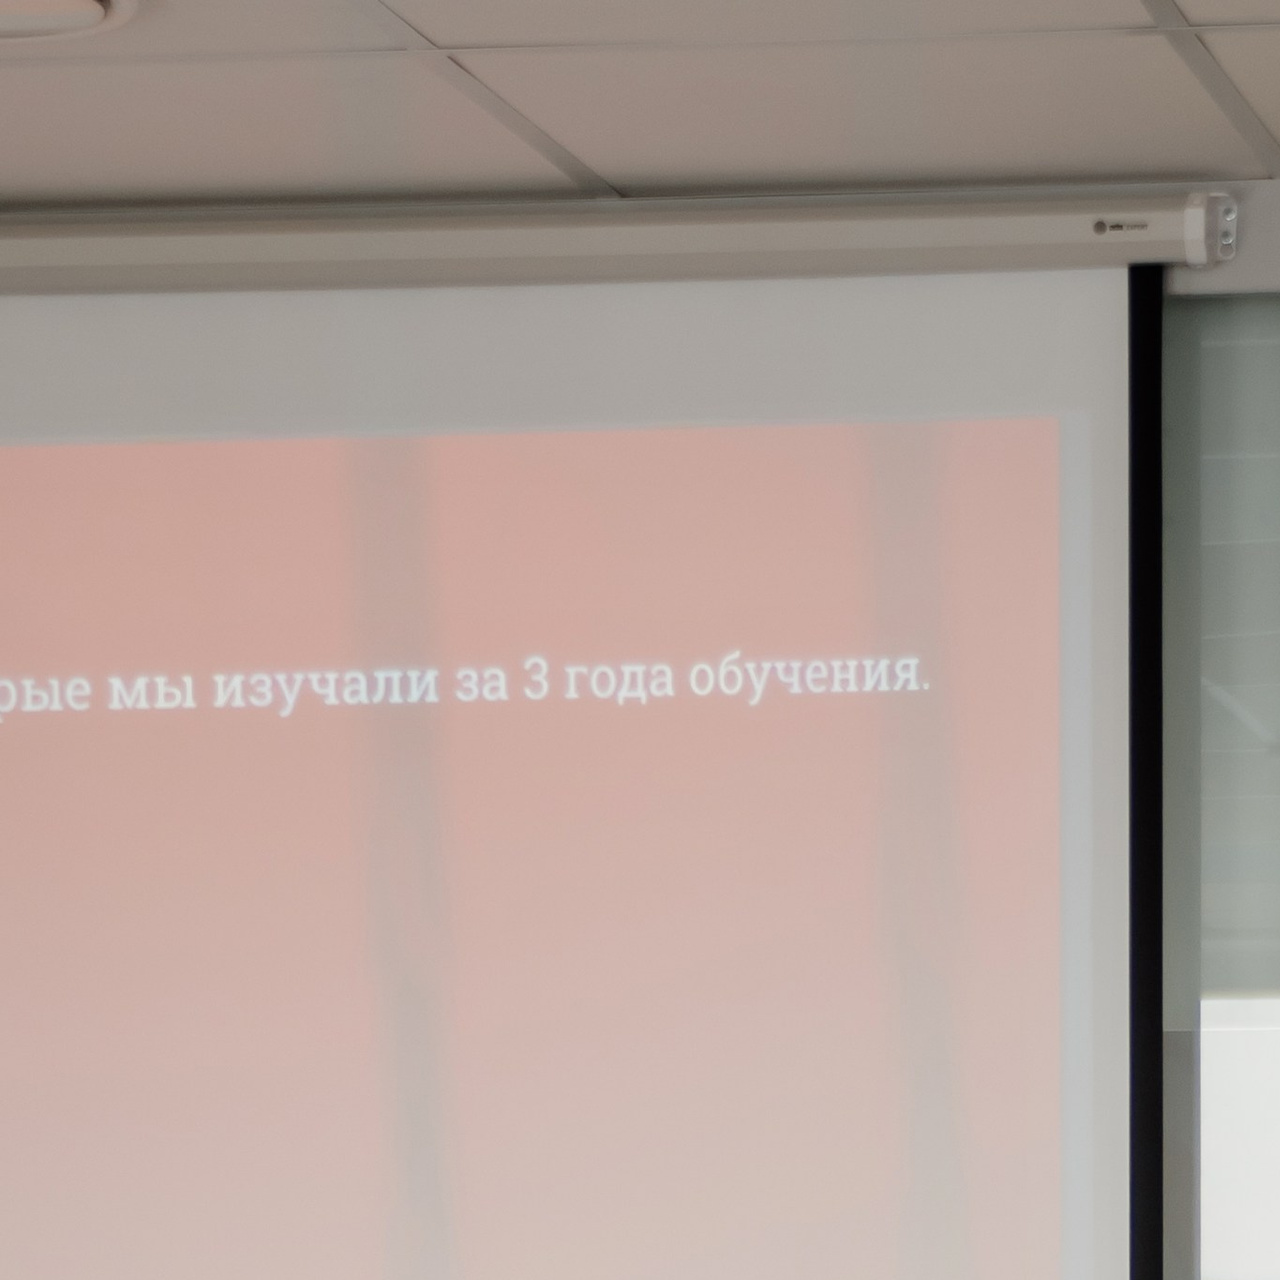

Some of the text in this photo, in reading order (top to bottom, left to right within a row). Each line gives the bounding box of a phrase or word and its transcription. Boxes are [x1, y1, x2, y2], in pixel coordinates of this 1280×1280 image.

[107, 674, 197, 710] мы
[212, 668, 441, 717] изучали
[455, 667, 507, 702] за
[523, 655, 550, 700] 3
[565, 664, 675, 706] года
[690, 650, 930, 706] обучения.
